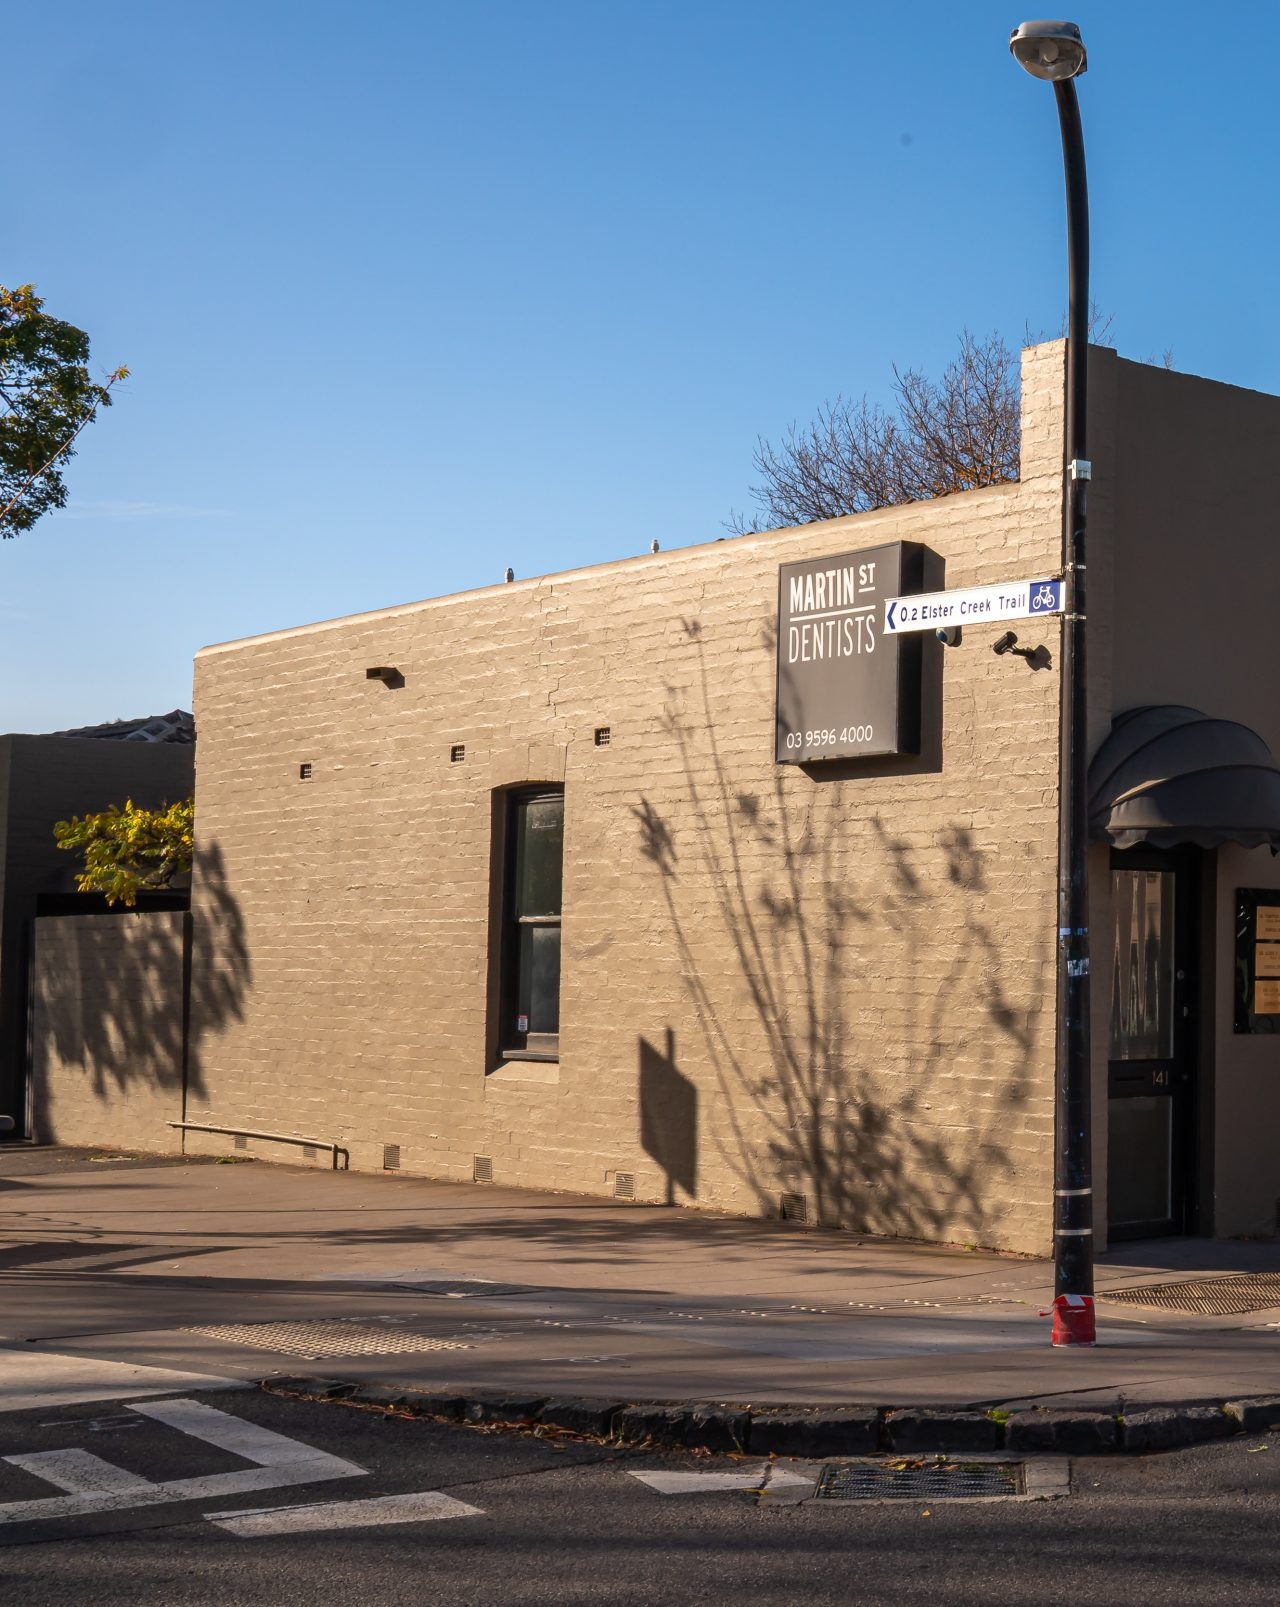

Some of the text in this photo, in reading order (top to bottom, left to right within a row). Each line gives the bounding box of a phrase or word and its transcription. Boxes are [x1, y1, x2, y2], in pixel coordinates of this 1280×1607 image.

[789, 562, 876, 614] MARTIN ST
[900, 593, 1026, 622] 0.2 Elster Creek Trail
[788, 614, 876, 664] DENTISTS
[786, 724, 873, 749] 03 9596 4000
[1152, 1070, 1169, 1087] 141
